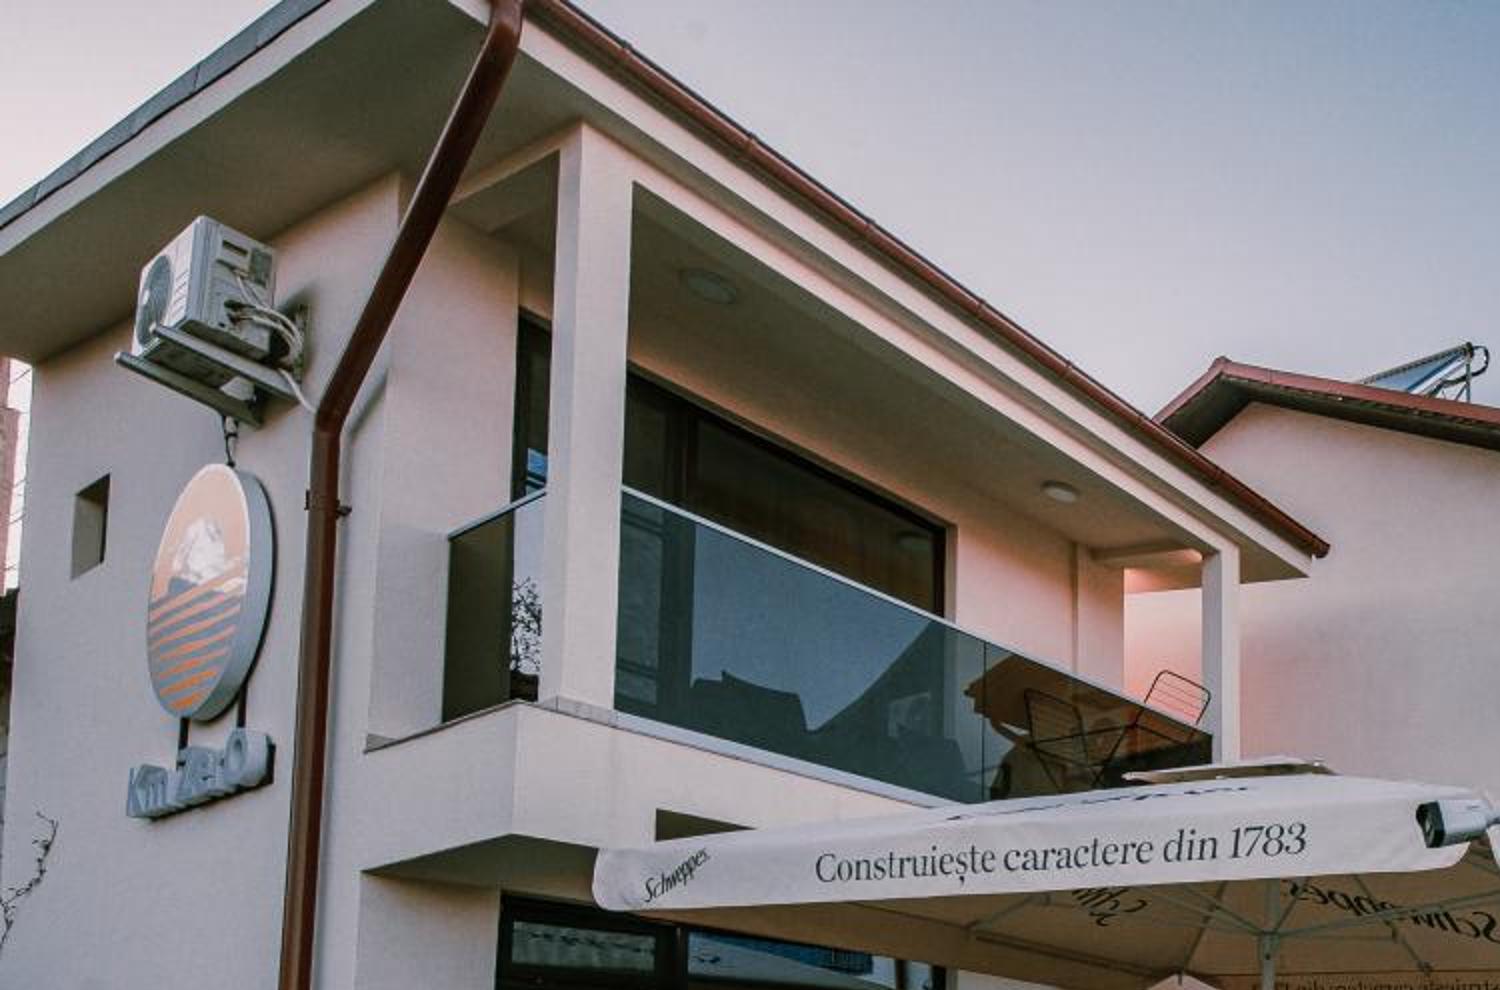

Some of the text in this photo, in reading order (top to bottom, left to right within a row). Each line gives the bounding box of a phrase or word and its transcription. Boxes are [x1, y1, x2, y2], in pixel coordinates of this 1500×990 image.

[644, 848, 711, 903] Schweppes
[815, 822, 1307, 883] Construiește caractere din 1783
